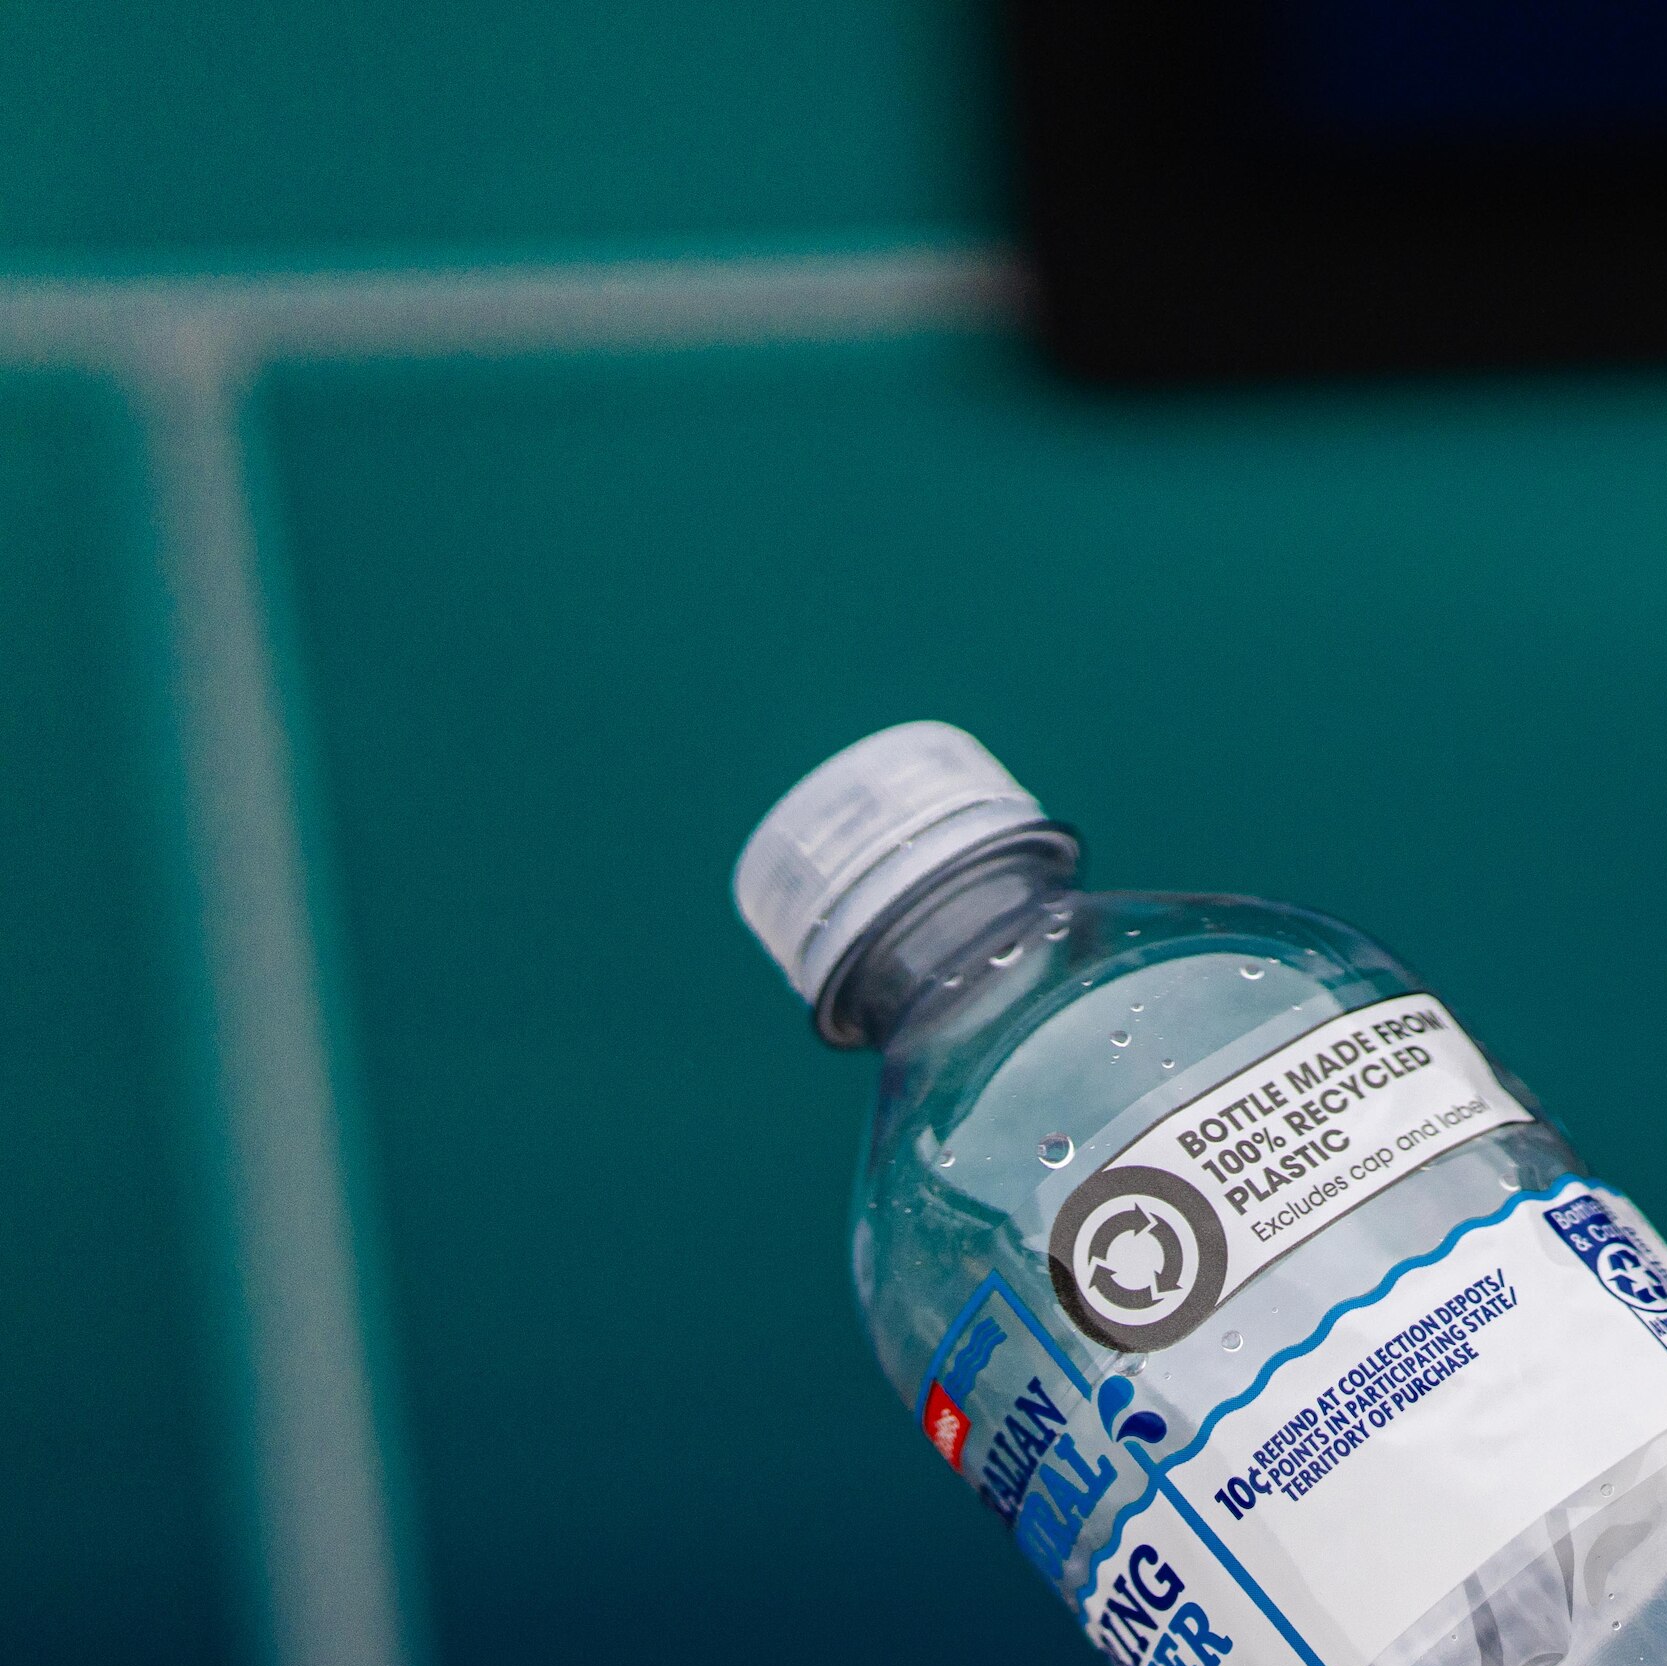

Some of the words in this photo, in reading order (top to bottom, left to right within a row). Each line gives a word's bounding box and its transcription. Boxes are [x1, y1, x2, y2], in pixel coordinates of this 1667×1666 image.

[1176, 1081, 1289, 1159] BOTTLE
[1284, 1031, 1378, 1094] MADE
[1201, 1127, 1287, 1184] 100%
[1283, 1046, 1432, 1136] RECYCLED
[1224, 1129, 1350, 1216] PLASTIC
[1250, 1176, 1349, 1242] Excludes
[1350, 1148, 1394, 1180] cap
[1396, 1119, 1441, 1151] and
[1434, 1096, 1491, 1128] label
[1253, 1408, 1318, 1470] REFUND
[1316, 1387, 1341, 1416] AT
[1338, 1314, 1441, 1395] COLLECTION
[1433, 1268, 1505, 1325] DEPOTS/
[1267, 1427, 1330, 1486] POINTS
[1324, 1409, 1350, 1436] IN
[1344, 1324, 1467, 1419] PARTICIPATING
[1461, 1286, 1517, 1333] STATE/
[1281, 1418, 1370, 1502] TERRITORY
[1368, 1400, 1394, 1428] OF
[1390, 1341, 1480, 1412] PURCHASE
